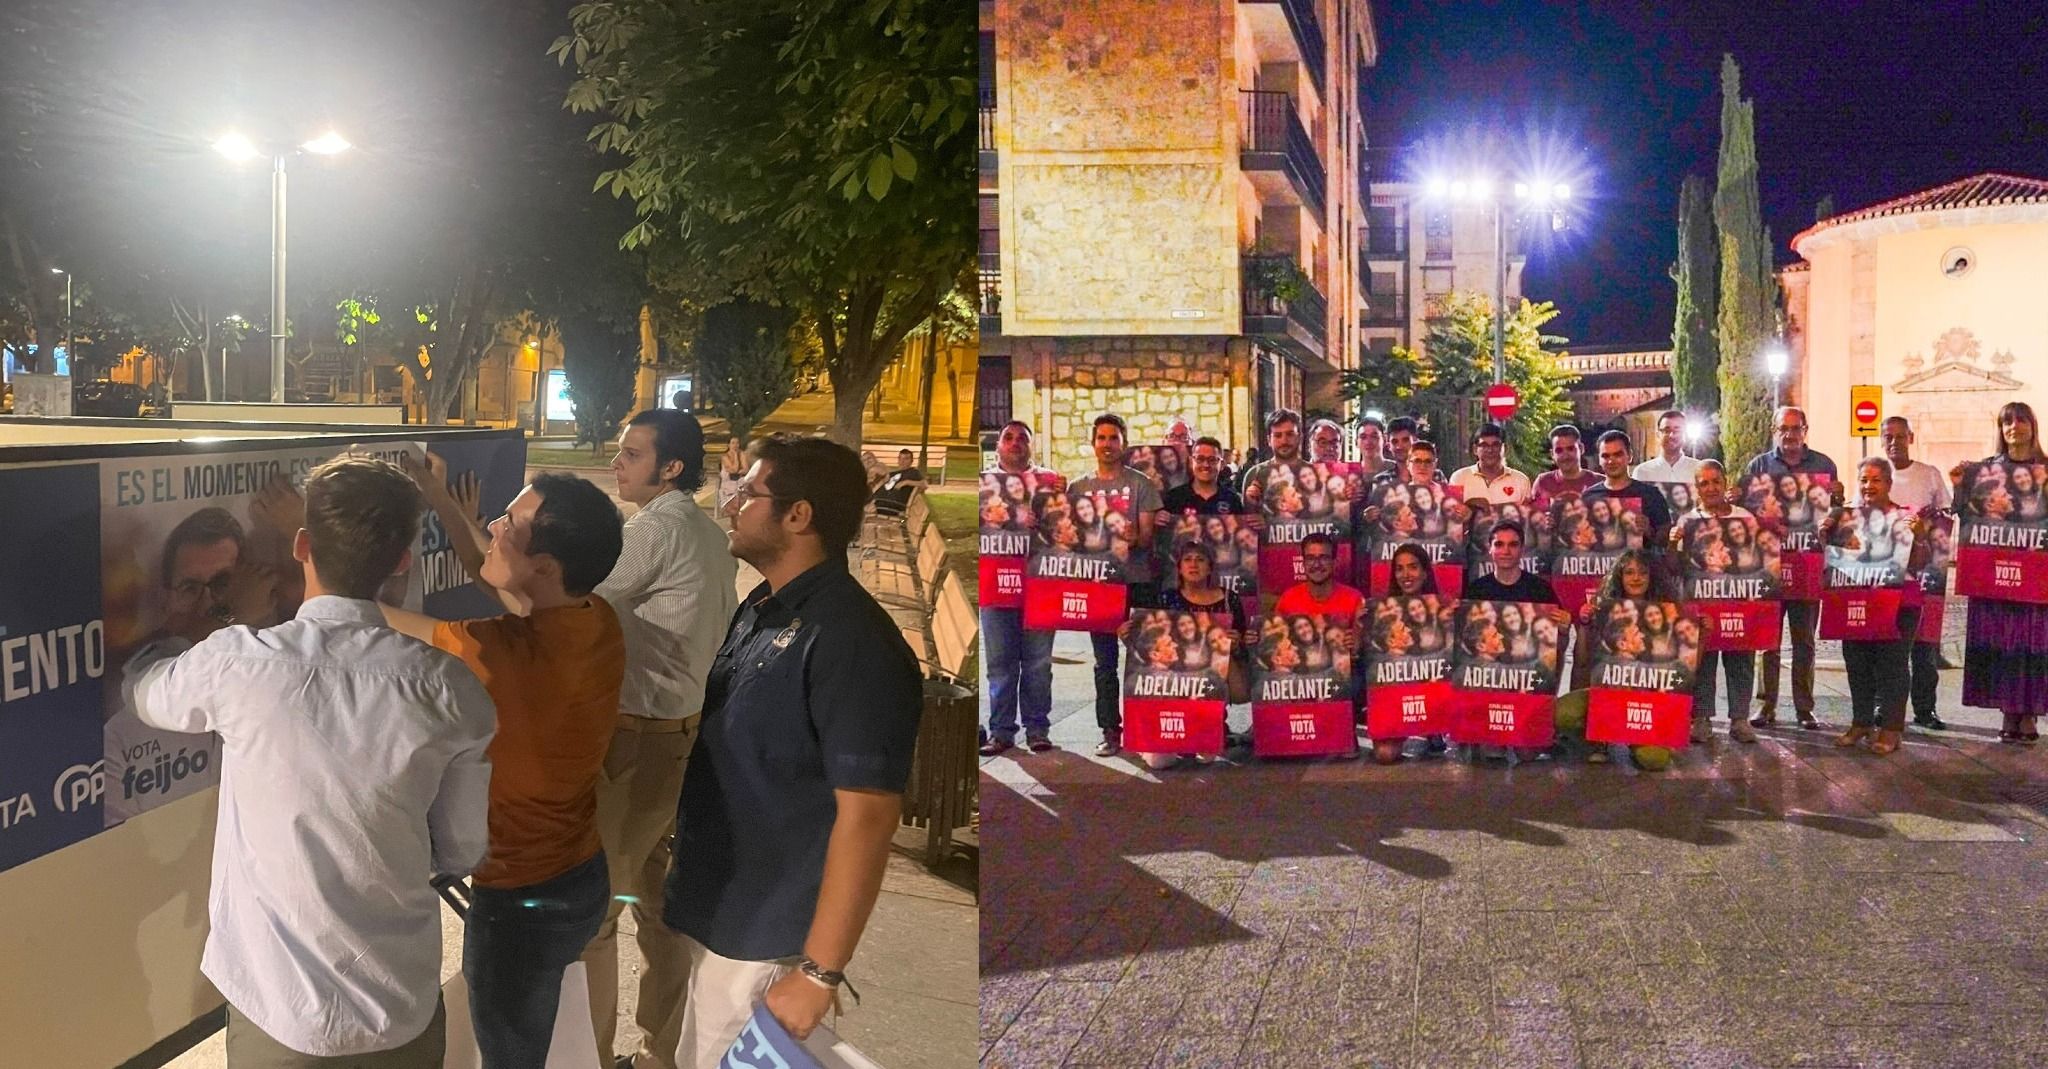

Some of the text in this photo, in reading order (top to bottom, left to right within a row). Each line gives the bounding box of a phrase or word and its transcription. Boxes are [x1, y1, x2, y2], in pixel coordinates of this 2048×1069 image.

[117, 468, 145, 507] ES
[152, 466, 178, 503] EL
[1995, 565, 2022, 580] VOTA
[997, 574, 1022, 587] VOTA
[1062, 598, 1088, 613] VOTA
[1720, 618, 1745, 631] VOTA
[1402, 700, 1426, 715] VOTA
[1489, 709, 1514, 724] VOTA
[1626, 709, 1653, 723] VOTA
[1159, 717, 1185, 732] VOTA
[1289, 719, 1316, 734] VOTA
[121, 738, 162, 763] VOTA
[121, 747, 209, 800] feijóo
